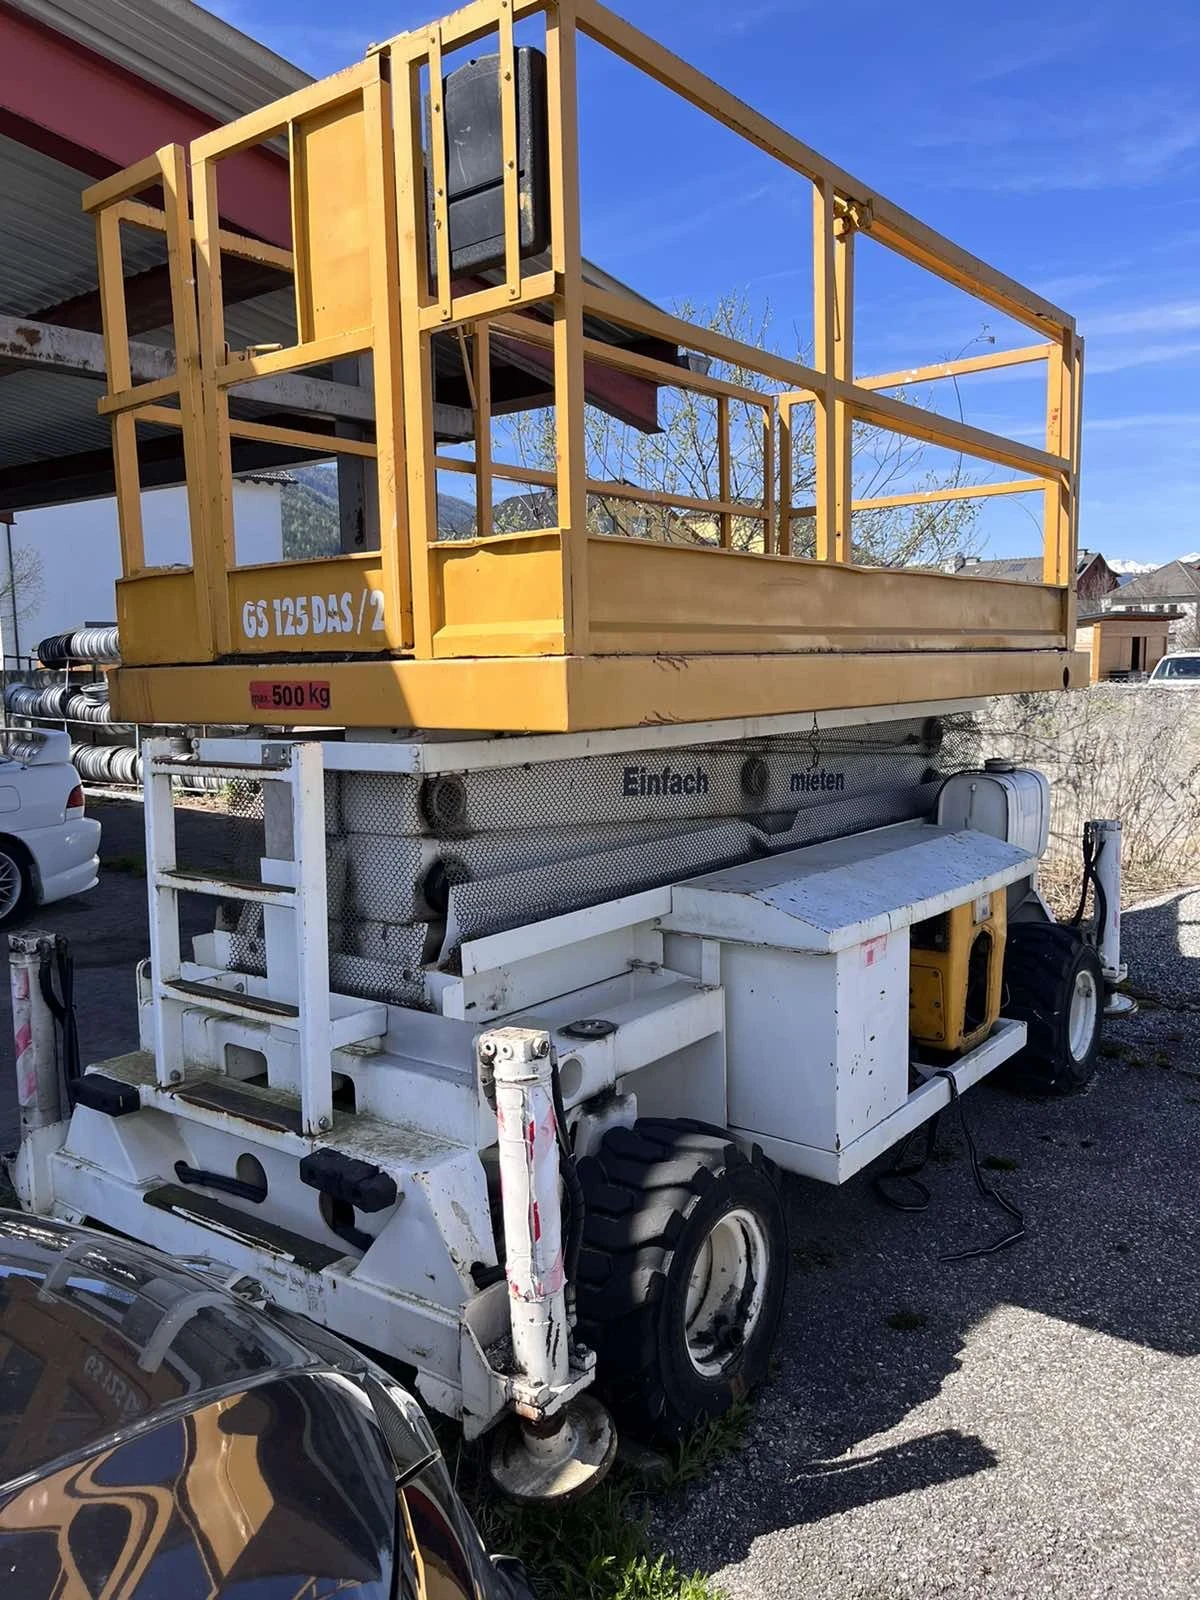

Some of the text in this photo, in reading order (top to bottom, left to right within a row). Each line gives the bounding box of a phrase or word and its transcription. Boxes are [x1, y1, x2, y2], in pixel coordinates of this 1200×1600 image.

[243, 600, 269, 638] GS
[273, 596, 308, 636] 125
[272, 685, 304, 706] 500
[309, 682, 330, 709] kg
[622, 767, 844, 796] Einfach mieten
